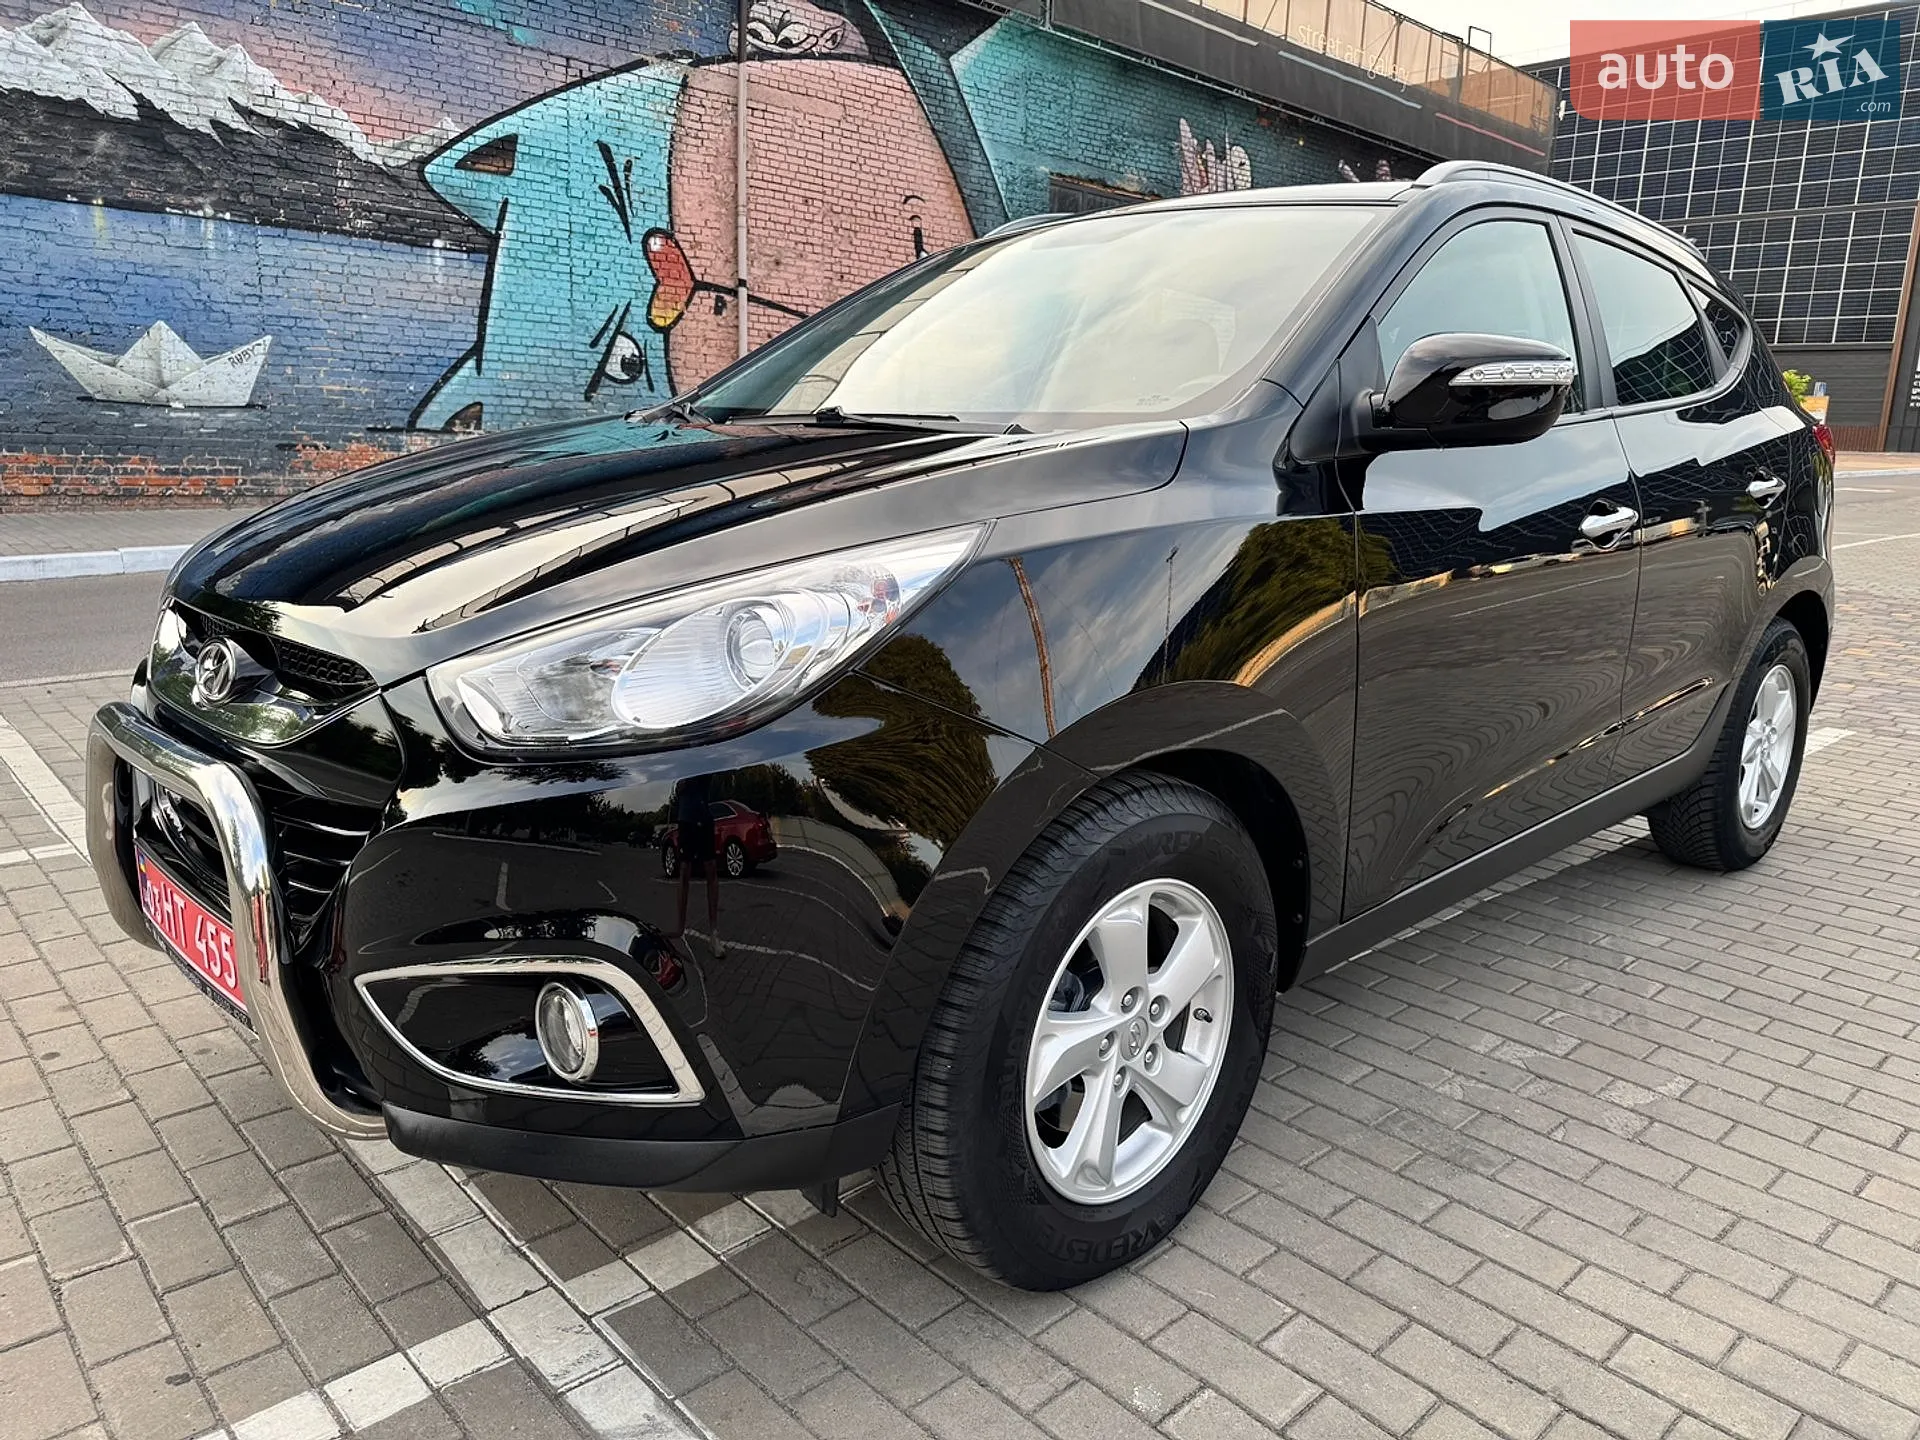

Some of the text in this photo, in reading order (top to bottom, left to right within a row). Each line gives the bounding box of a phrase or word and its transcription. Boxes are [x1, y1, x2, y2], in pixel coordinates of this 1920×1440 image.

[1298, 24, 1410, 92] street art gallery
[195, 914, 241, 990] 455
